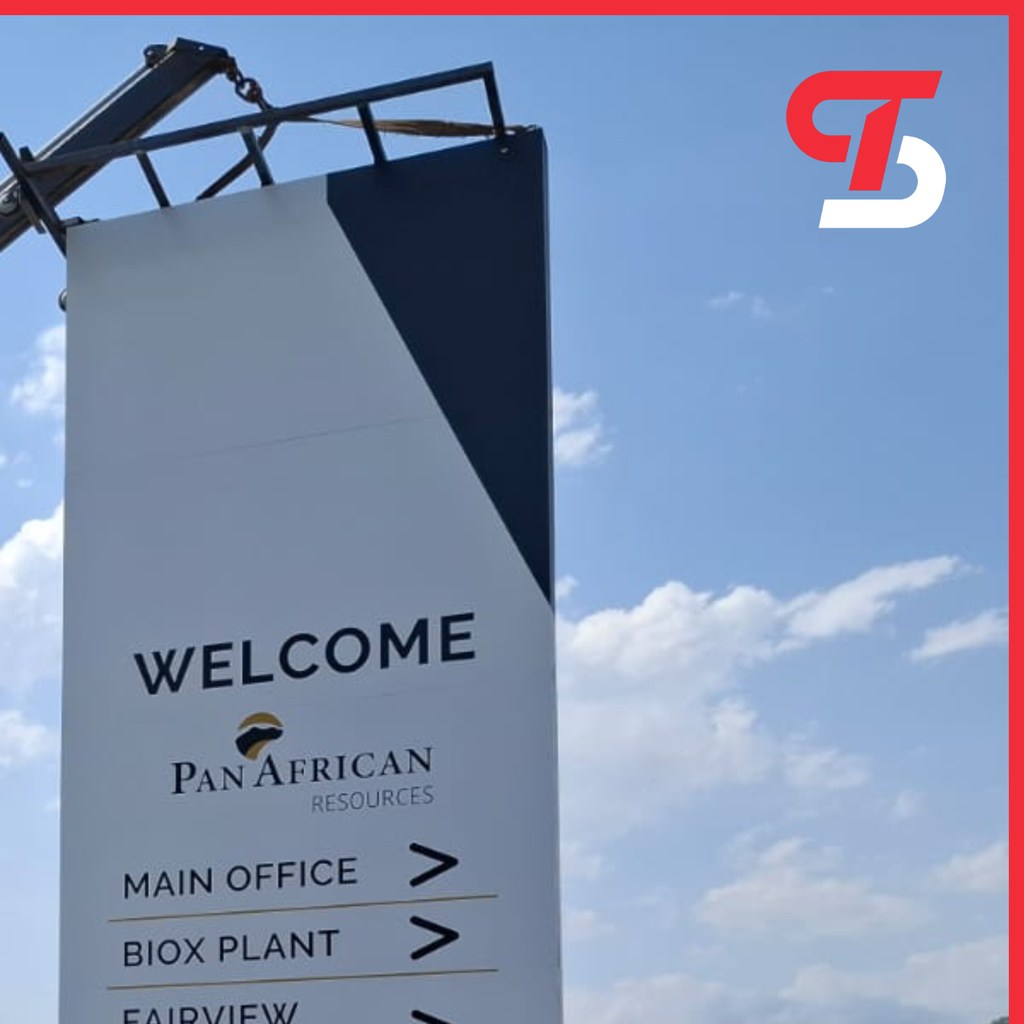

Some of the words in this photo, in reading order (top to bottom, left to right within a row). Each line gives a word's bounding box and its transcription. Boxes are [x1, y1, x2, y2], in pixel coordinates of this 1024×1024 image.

[133, 612, 476, 696] WELCOME
[311, 785, 435, 812] RESOURCES
[124, 867, 213, 899] MAIN
[226, 857, 358, 892] OFFICE
[123, 937, 205, 967] BIOX
[219, 929, 340, 962] PLANT
